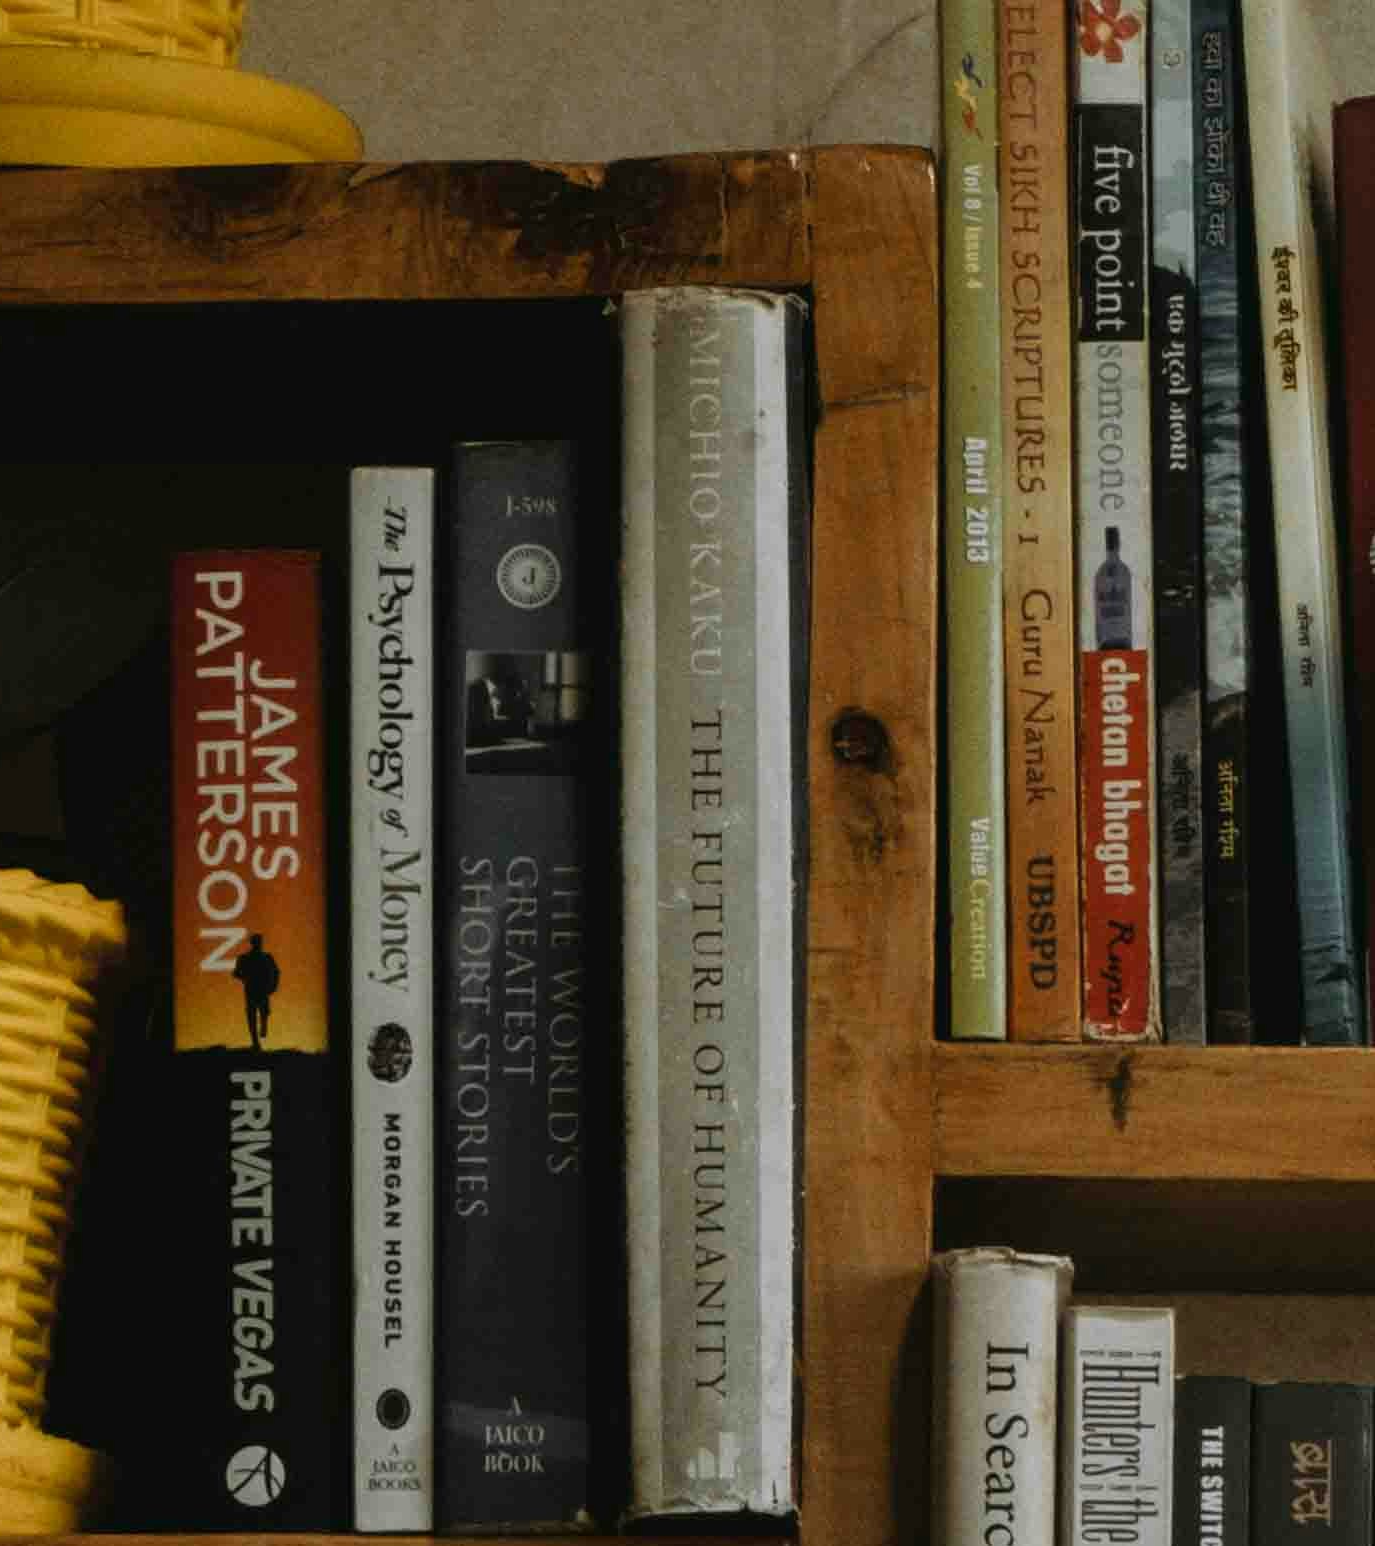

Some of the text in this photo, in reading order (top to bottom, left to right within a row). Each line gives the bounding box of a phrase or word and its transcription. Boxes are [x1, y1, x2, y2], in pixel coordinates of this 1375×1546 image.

[1082, 143, 1132, 511] five point someone
[961, 436, 991, 563] April 2013
[194, 571, 246, 975] PATTERSON
[248, 658, 298, 881] JAMES
[369, 506, 421, 993] The Psychology of Money
[688, 327, 726, 1399] MICHIO KAKU THE FUTURE OF HUMANITY
[1016, 589, 1058, 990] Guru Nanak UBSPD
[1091, 657, 1135, 896] chetan bhagat
[229, 1071, 274, 1413] PRIVATE VEGAS
[383, 1113, 401, 1348] MORGAN HOUSEL
[984, 1342, 1029, 1396] In
